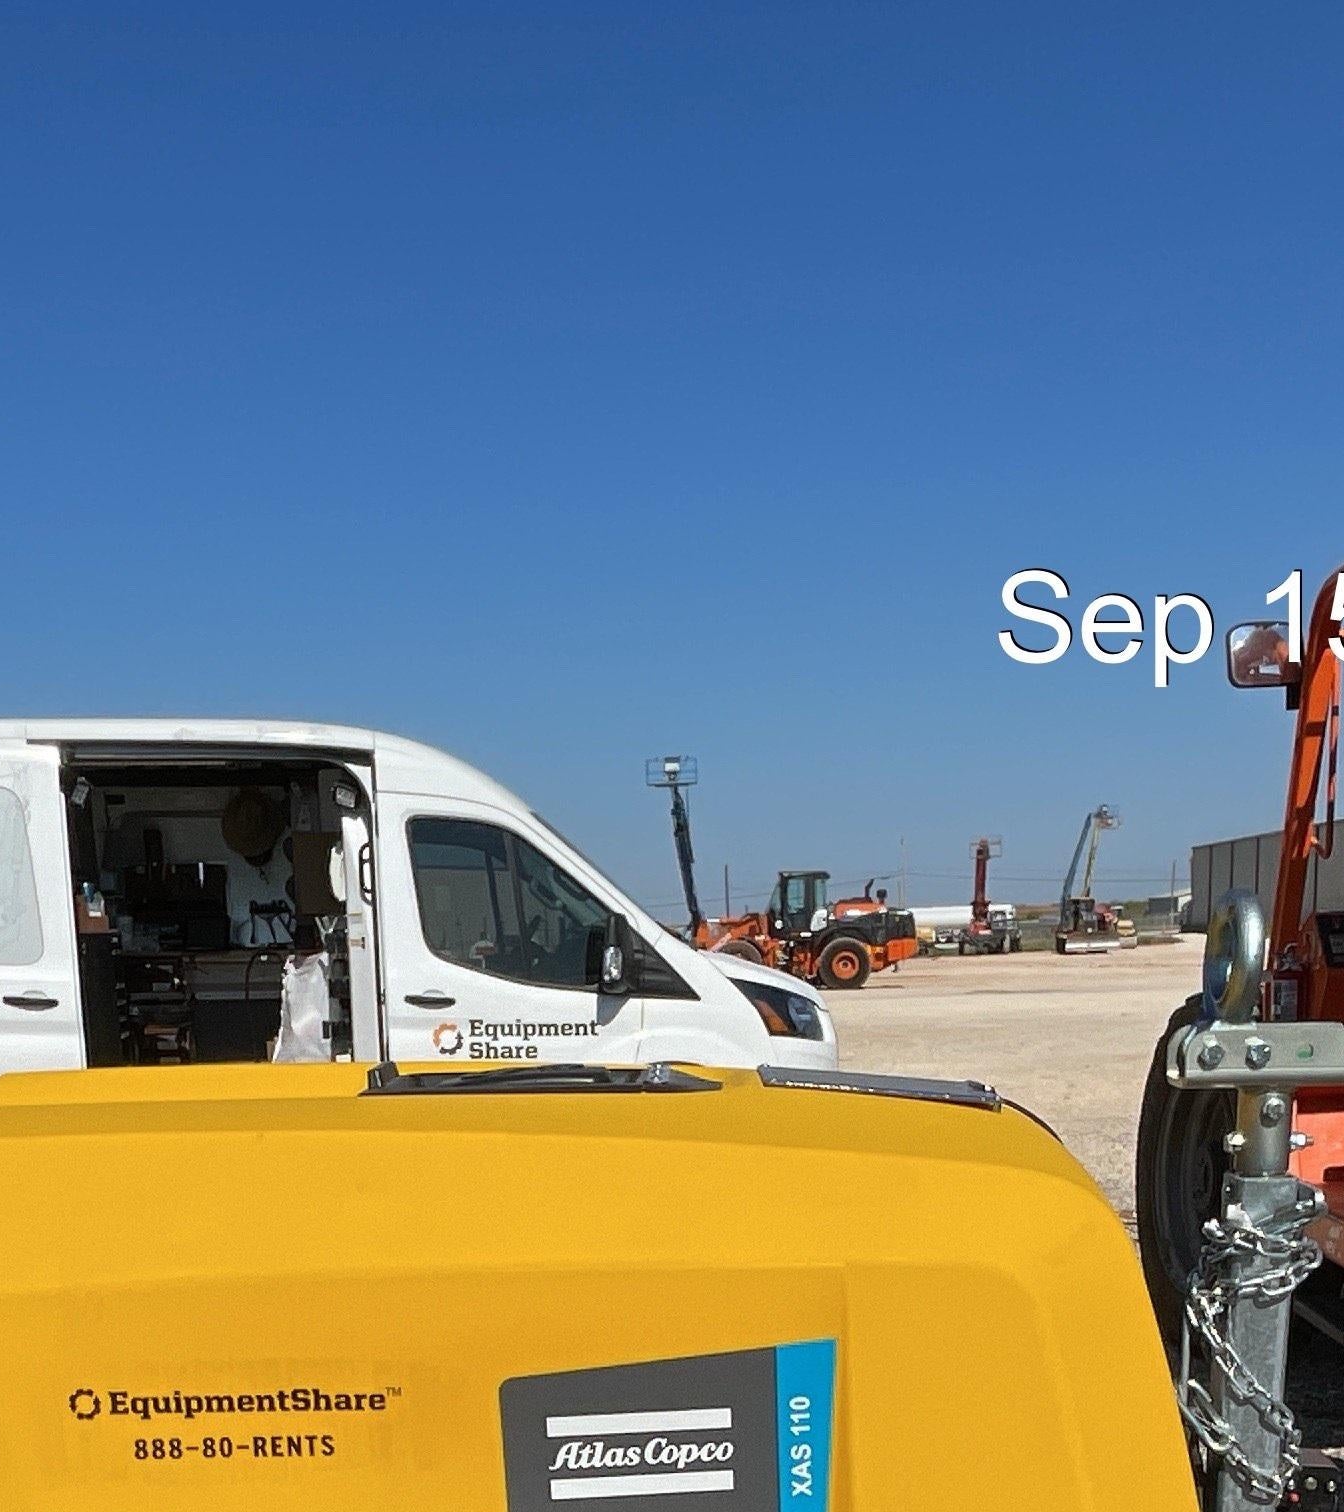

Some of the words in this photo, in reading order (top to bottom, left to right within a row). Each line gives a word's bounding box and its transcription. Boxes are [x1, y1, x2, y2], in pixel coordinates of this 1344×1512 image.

[468, 1018, 599, 1041] Equipment
[468, 1042, 538, 1059] Share
[108, 1387, 386, 1421] EquipmentShare
[788, 1395, 812, 1437] 110
[134, 1434, 336, 1461] 888-80-RENTS
[549, 1440, 641, 1471] Atlas
[643, 1437, 734, 1469] Copco
[789, 1443, 814, 1498] XAS
